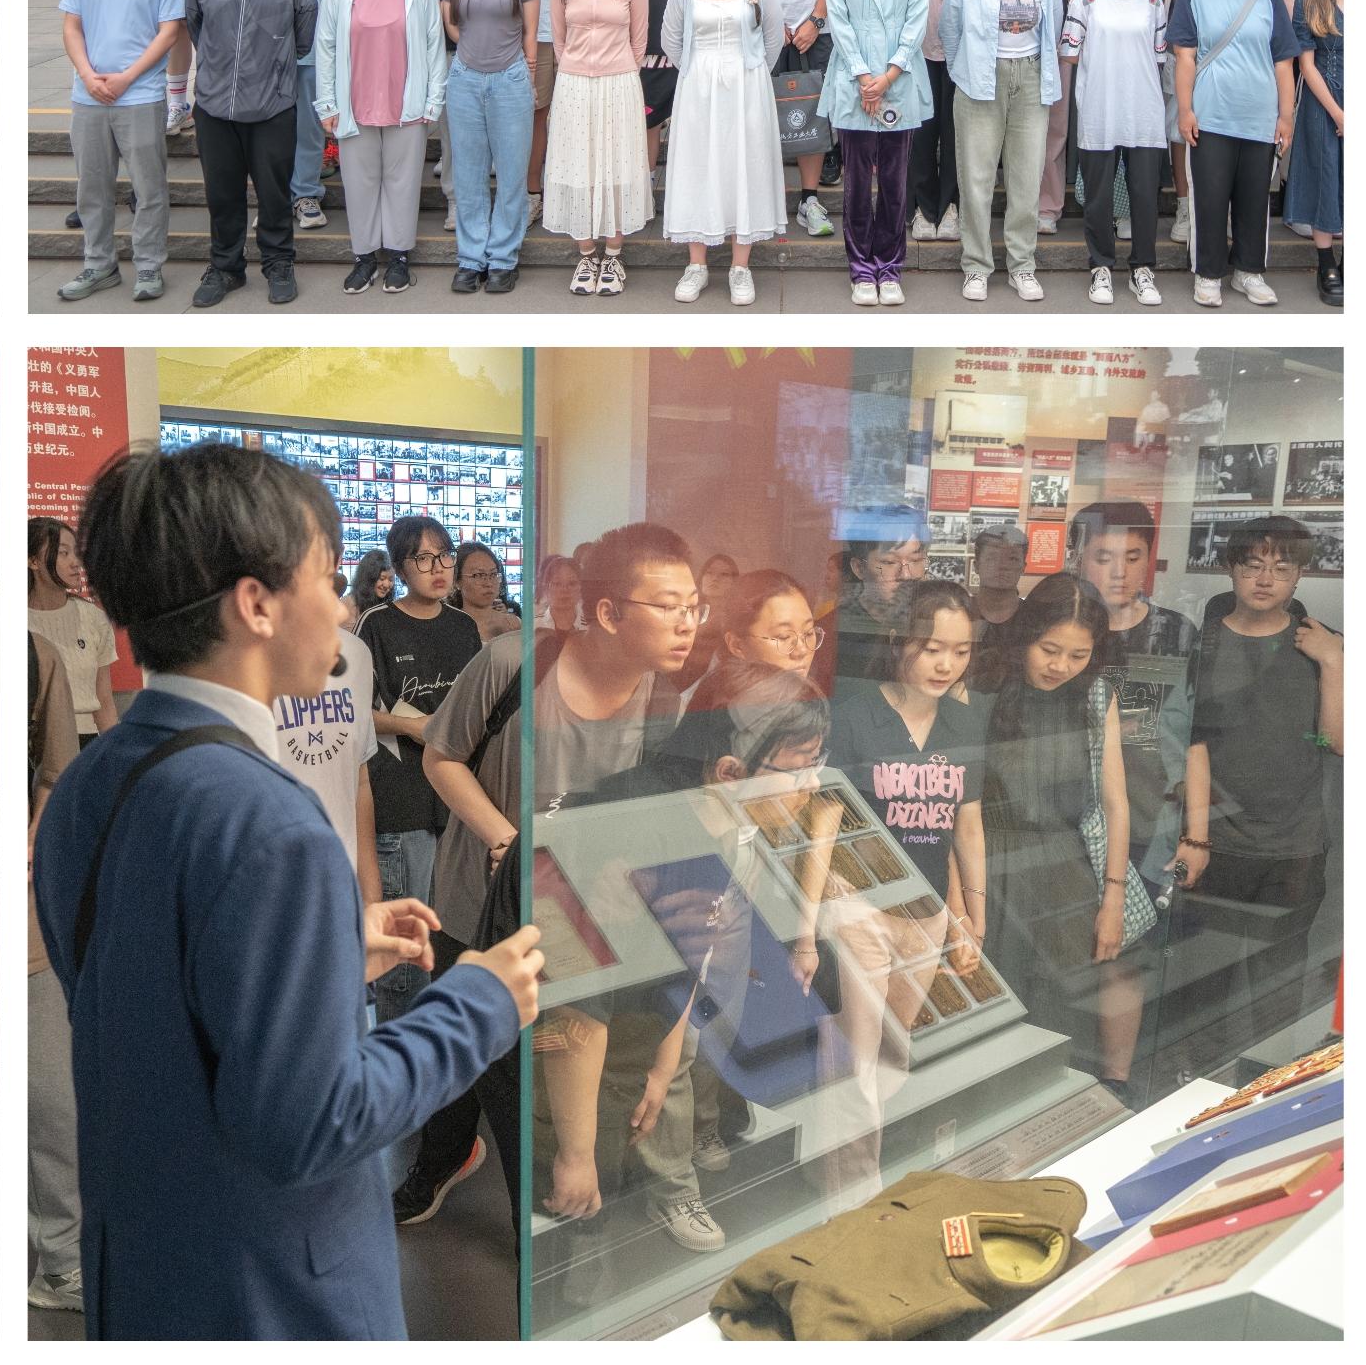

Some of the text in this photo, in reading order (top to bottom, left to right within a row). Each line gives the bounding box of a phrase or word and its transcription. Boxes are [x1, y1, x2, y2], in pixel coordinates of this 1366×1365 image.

[27, 400, 96, 418] 伐接受检阅。
[276, 687, 355, 731] LIPPERS
[287, 730, 349, 766] BASKETBALL
